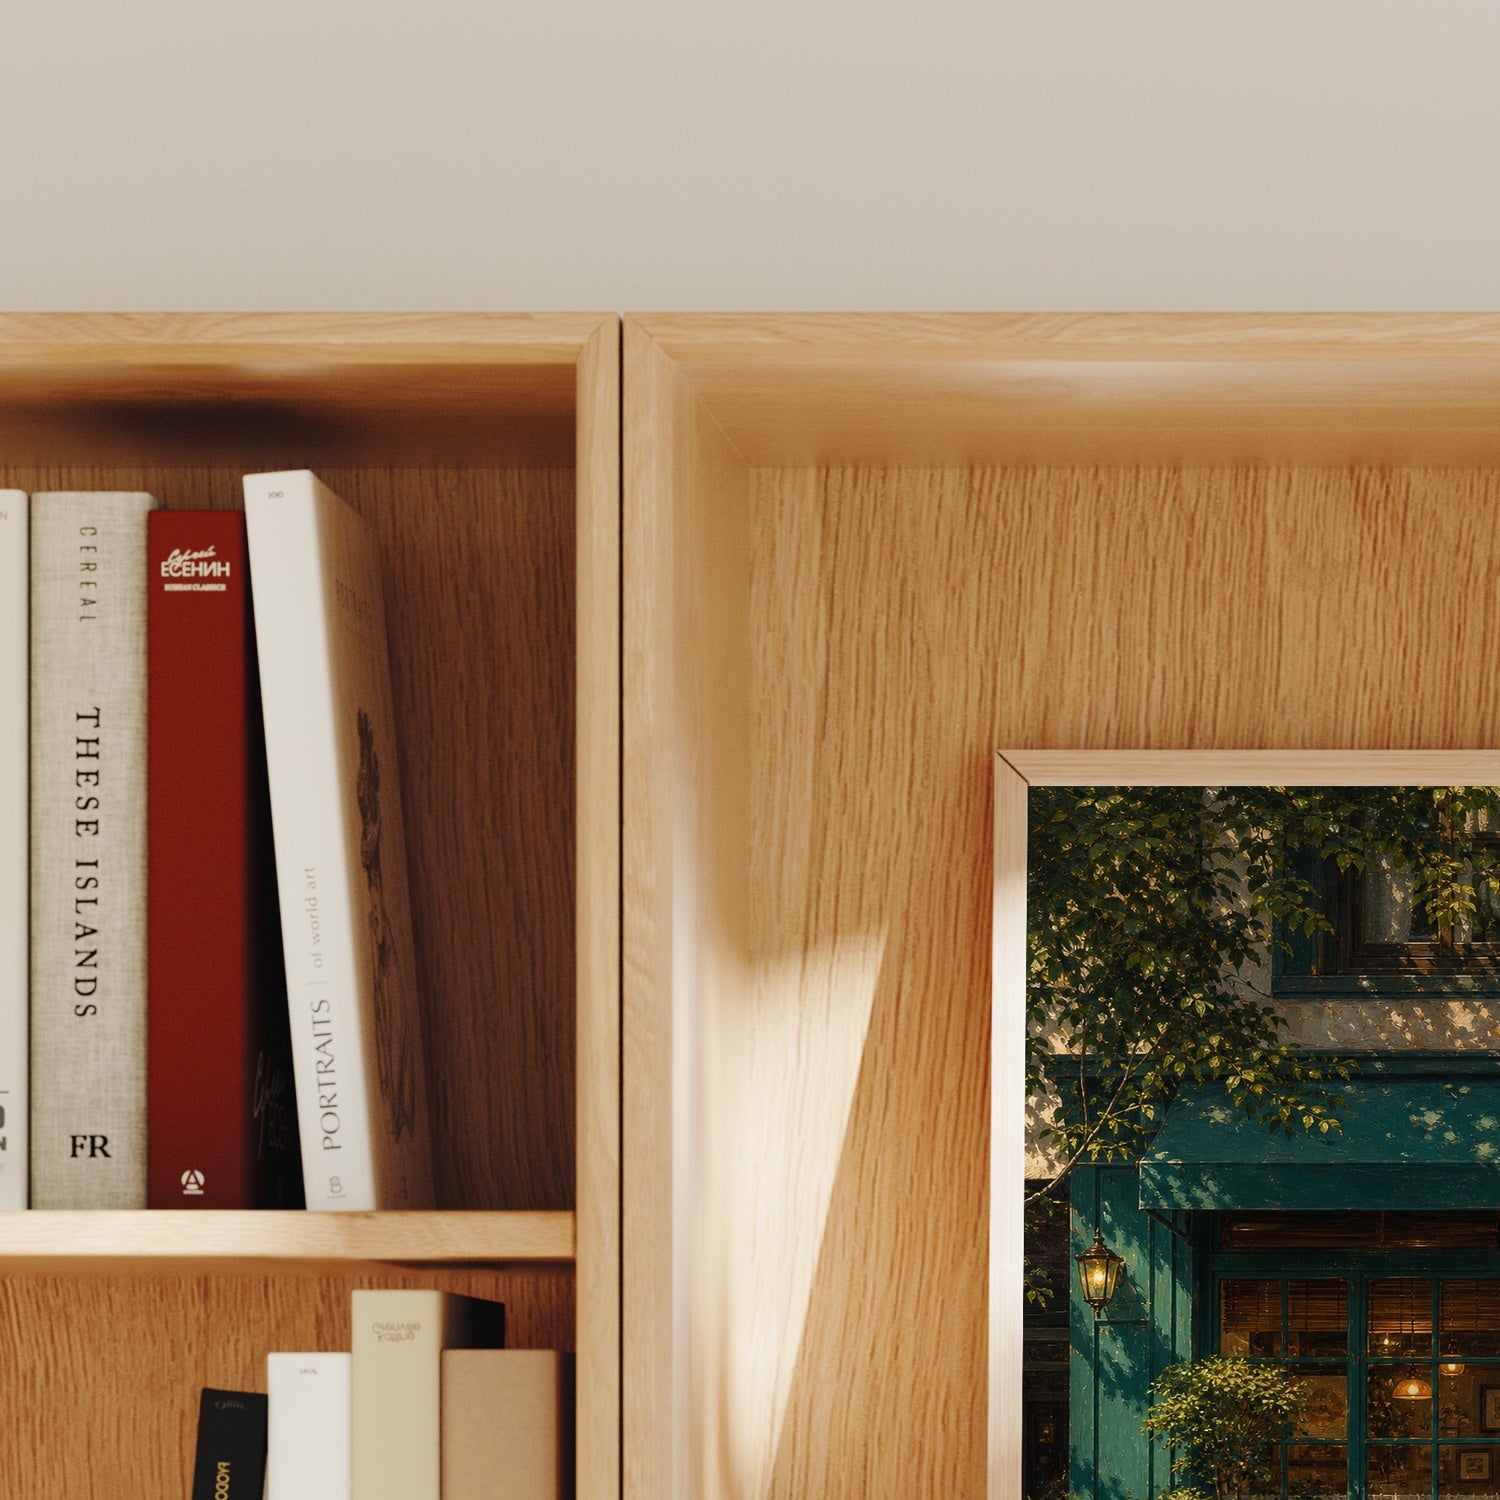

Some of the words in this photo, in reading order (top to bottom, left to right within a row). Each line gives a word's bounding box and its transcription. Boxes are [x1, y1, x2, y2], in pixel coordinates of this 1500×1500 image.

[79, 526, 98, 622] CEREAL
[160, 561, 231, 577] ЕСЕНИН
[75, 706, 101, 837] THESE
[304, 866, 316, 889] art
[74, 859, 99, 1018] ISLANDS
[305, 897, 321, 948] world
[312, 954, 323, 968] of
[310, 999, 342, 1151] PORTRAITS
[69, 1134, 113, 1158] FR
